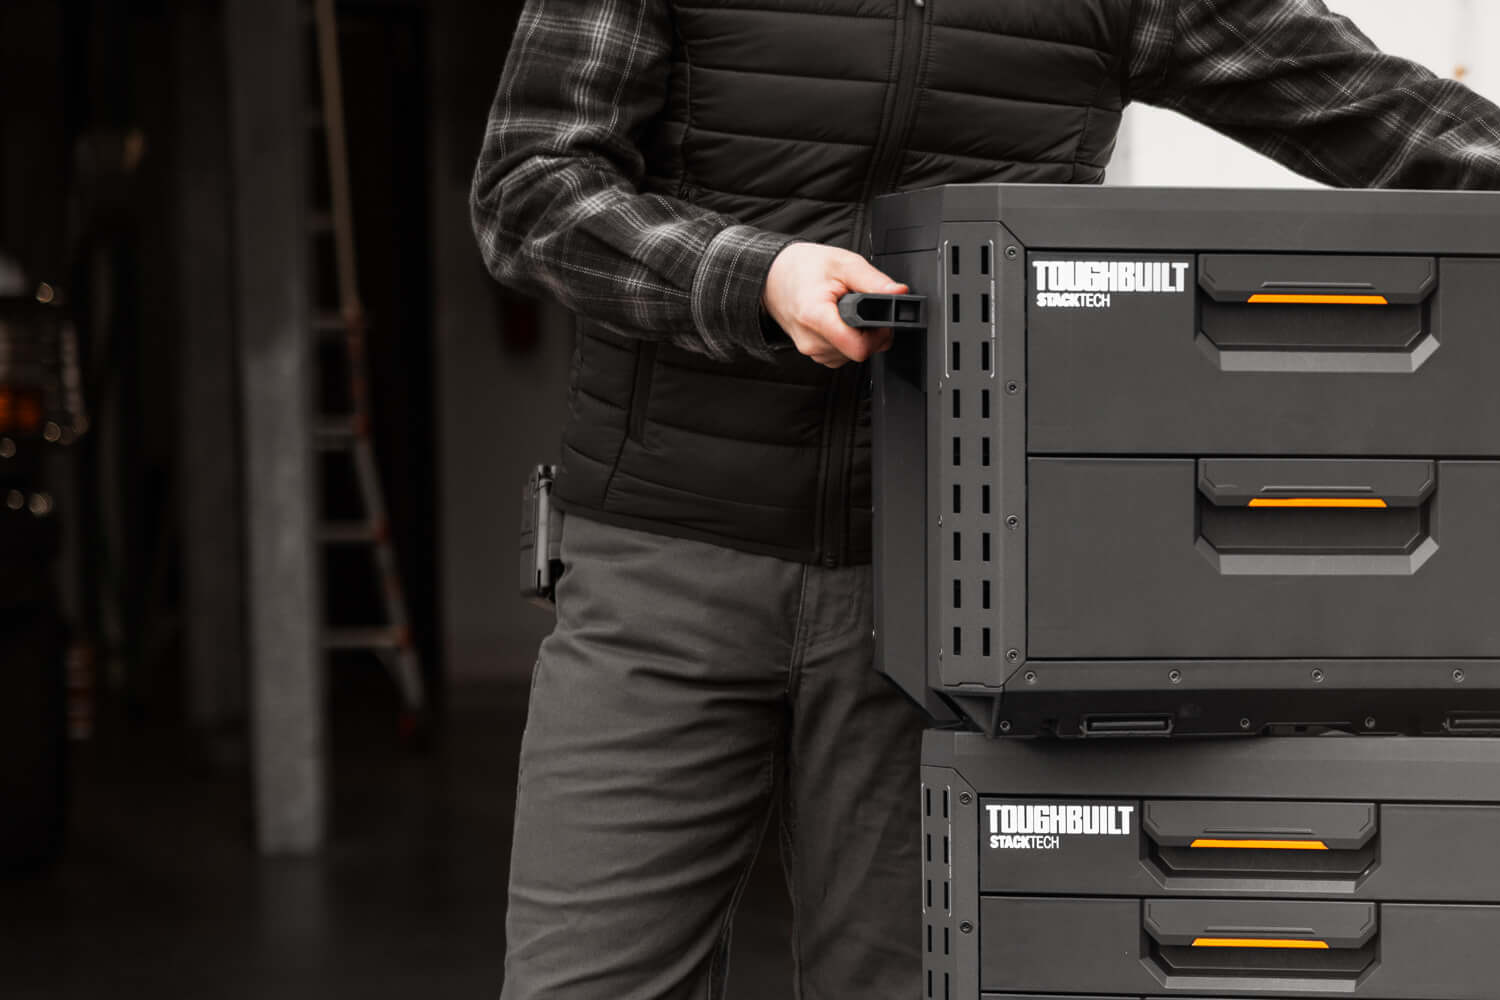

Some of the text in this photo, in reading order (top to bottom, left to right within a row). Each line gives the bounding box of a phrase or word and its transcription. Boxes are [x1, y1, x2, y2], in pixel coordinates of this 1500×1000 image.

[1032, 261, 1189, 292] TOUGHBUILT
[1036, 293, 1111, 307] STACKTECH
[985, 804, 1134, 834] TOUGHBUILT
[990, 835, 1060, 849] STACKTECH
